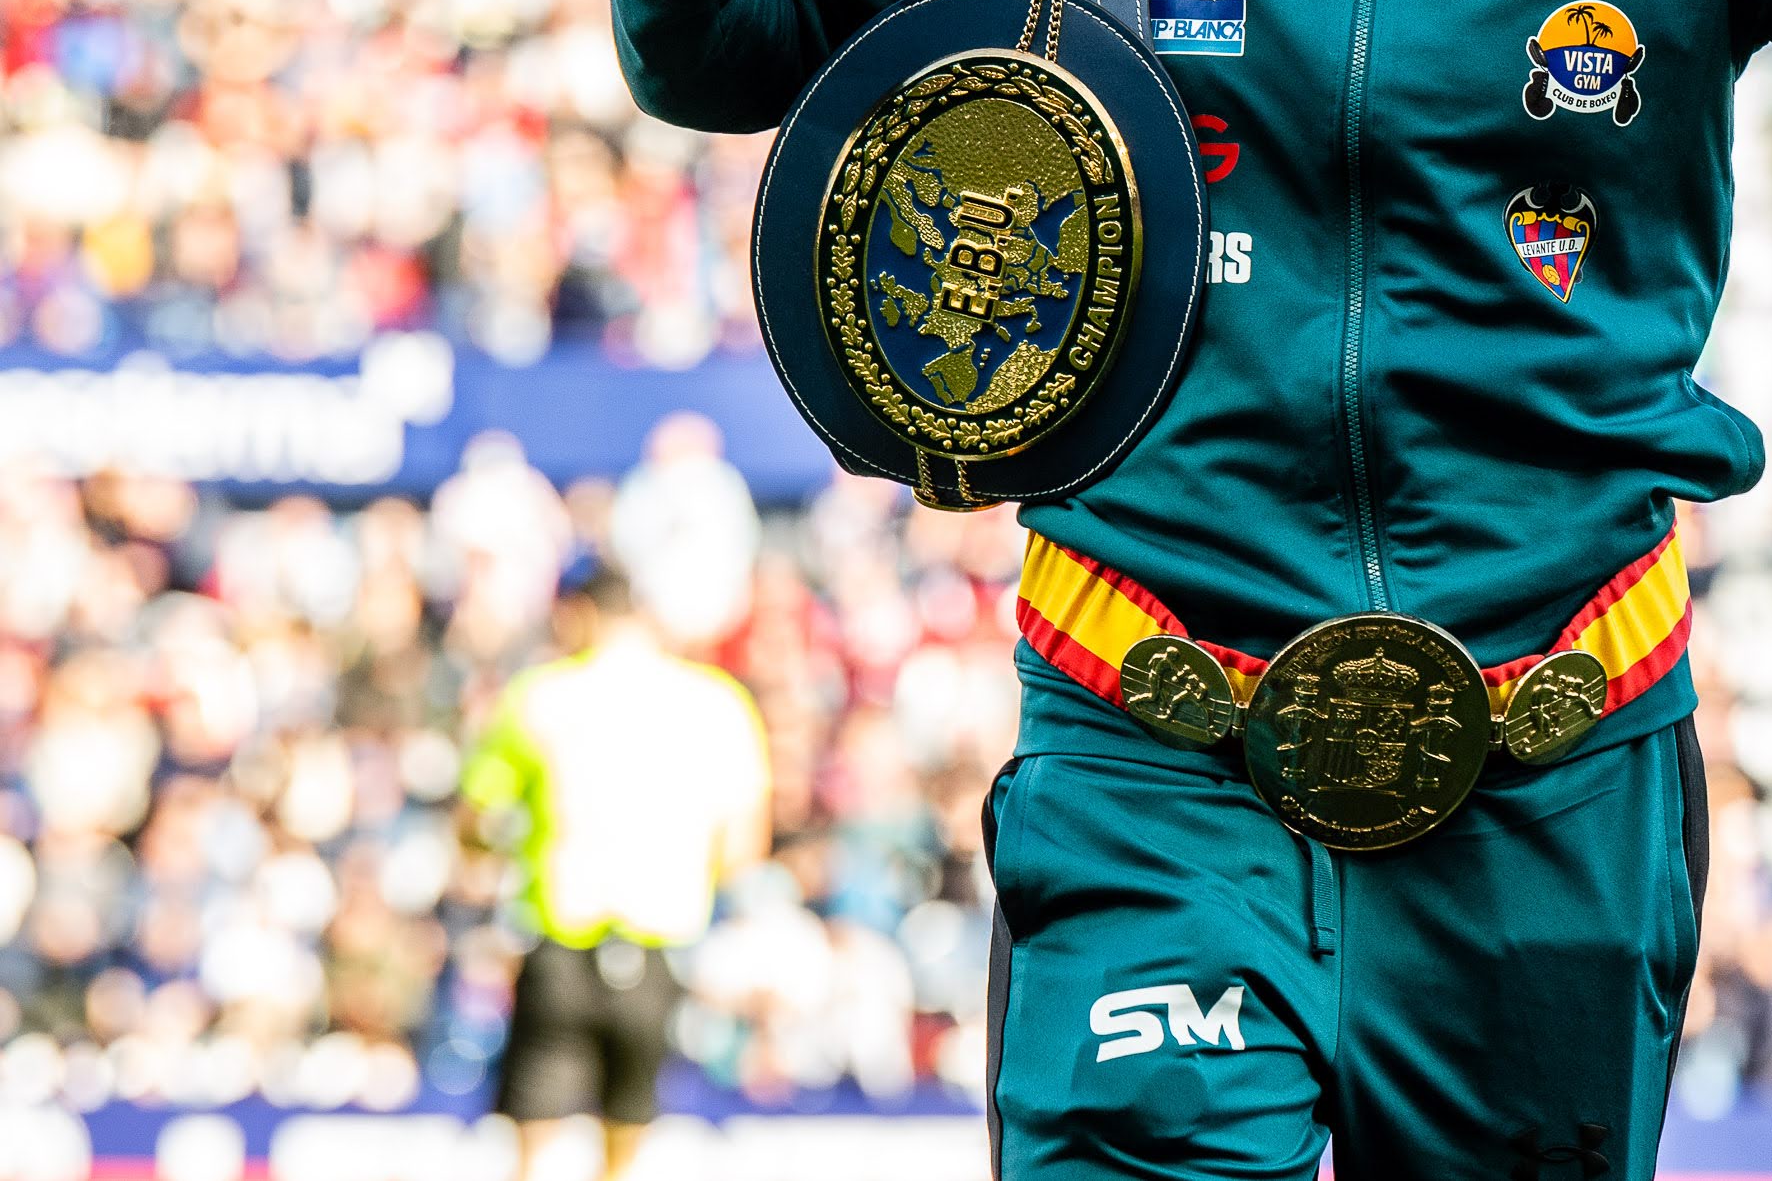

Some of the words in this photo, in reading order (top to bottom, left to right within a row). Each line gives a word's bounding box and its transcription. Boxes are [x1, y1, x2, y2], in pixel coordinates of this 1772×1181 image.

[1564, 50, 1613, 75] VISTA
[1573, 73, 1602, 91] GYM
[1552, 88, 1575, 106] CLUB
[1575, 99, 1588, 109] DE
[1589, 91, 1617, 109] BOXEO
[1522, 240, 1557, 256] LEVANTE
[1559, 238, 1579, 252] U.D.
[1068, 193, 1123, 371] CHAMPION
[1089, 983, 1246, 1064] SM
